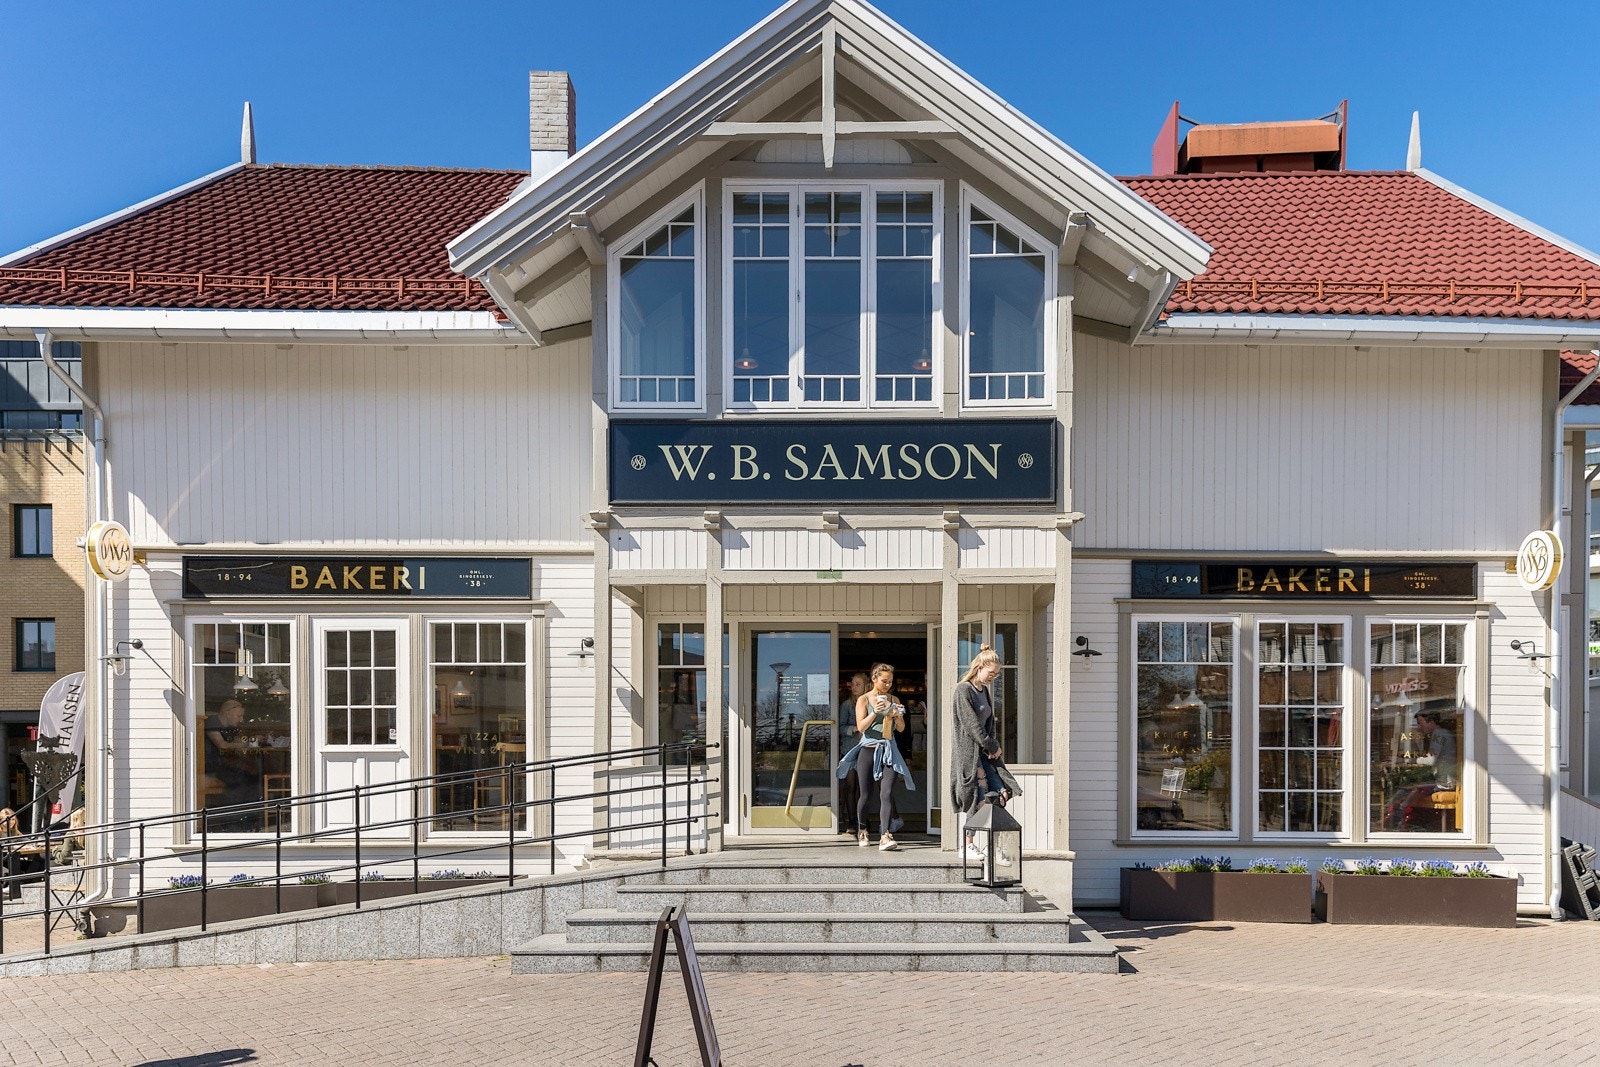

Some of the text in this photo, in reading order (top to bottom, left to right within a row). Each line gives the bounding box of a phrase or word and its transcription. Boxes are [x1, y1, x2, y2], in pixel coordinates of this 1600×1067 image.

[657, 442, 1003, 482] W. B. SAMSON
[290, 565, 426, 590] BAKERI
[1237, 568, 1370, 592] BAKERI
[58, 683, 81, 748] HANSEN
